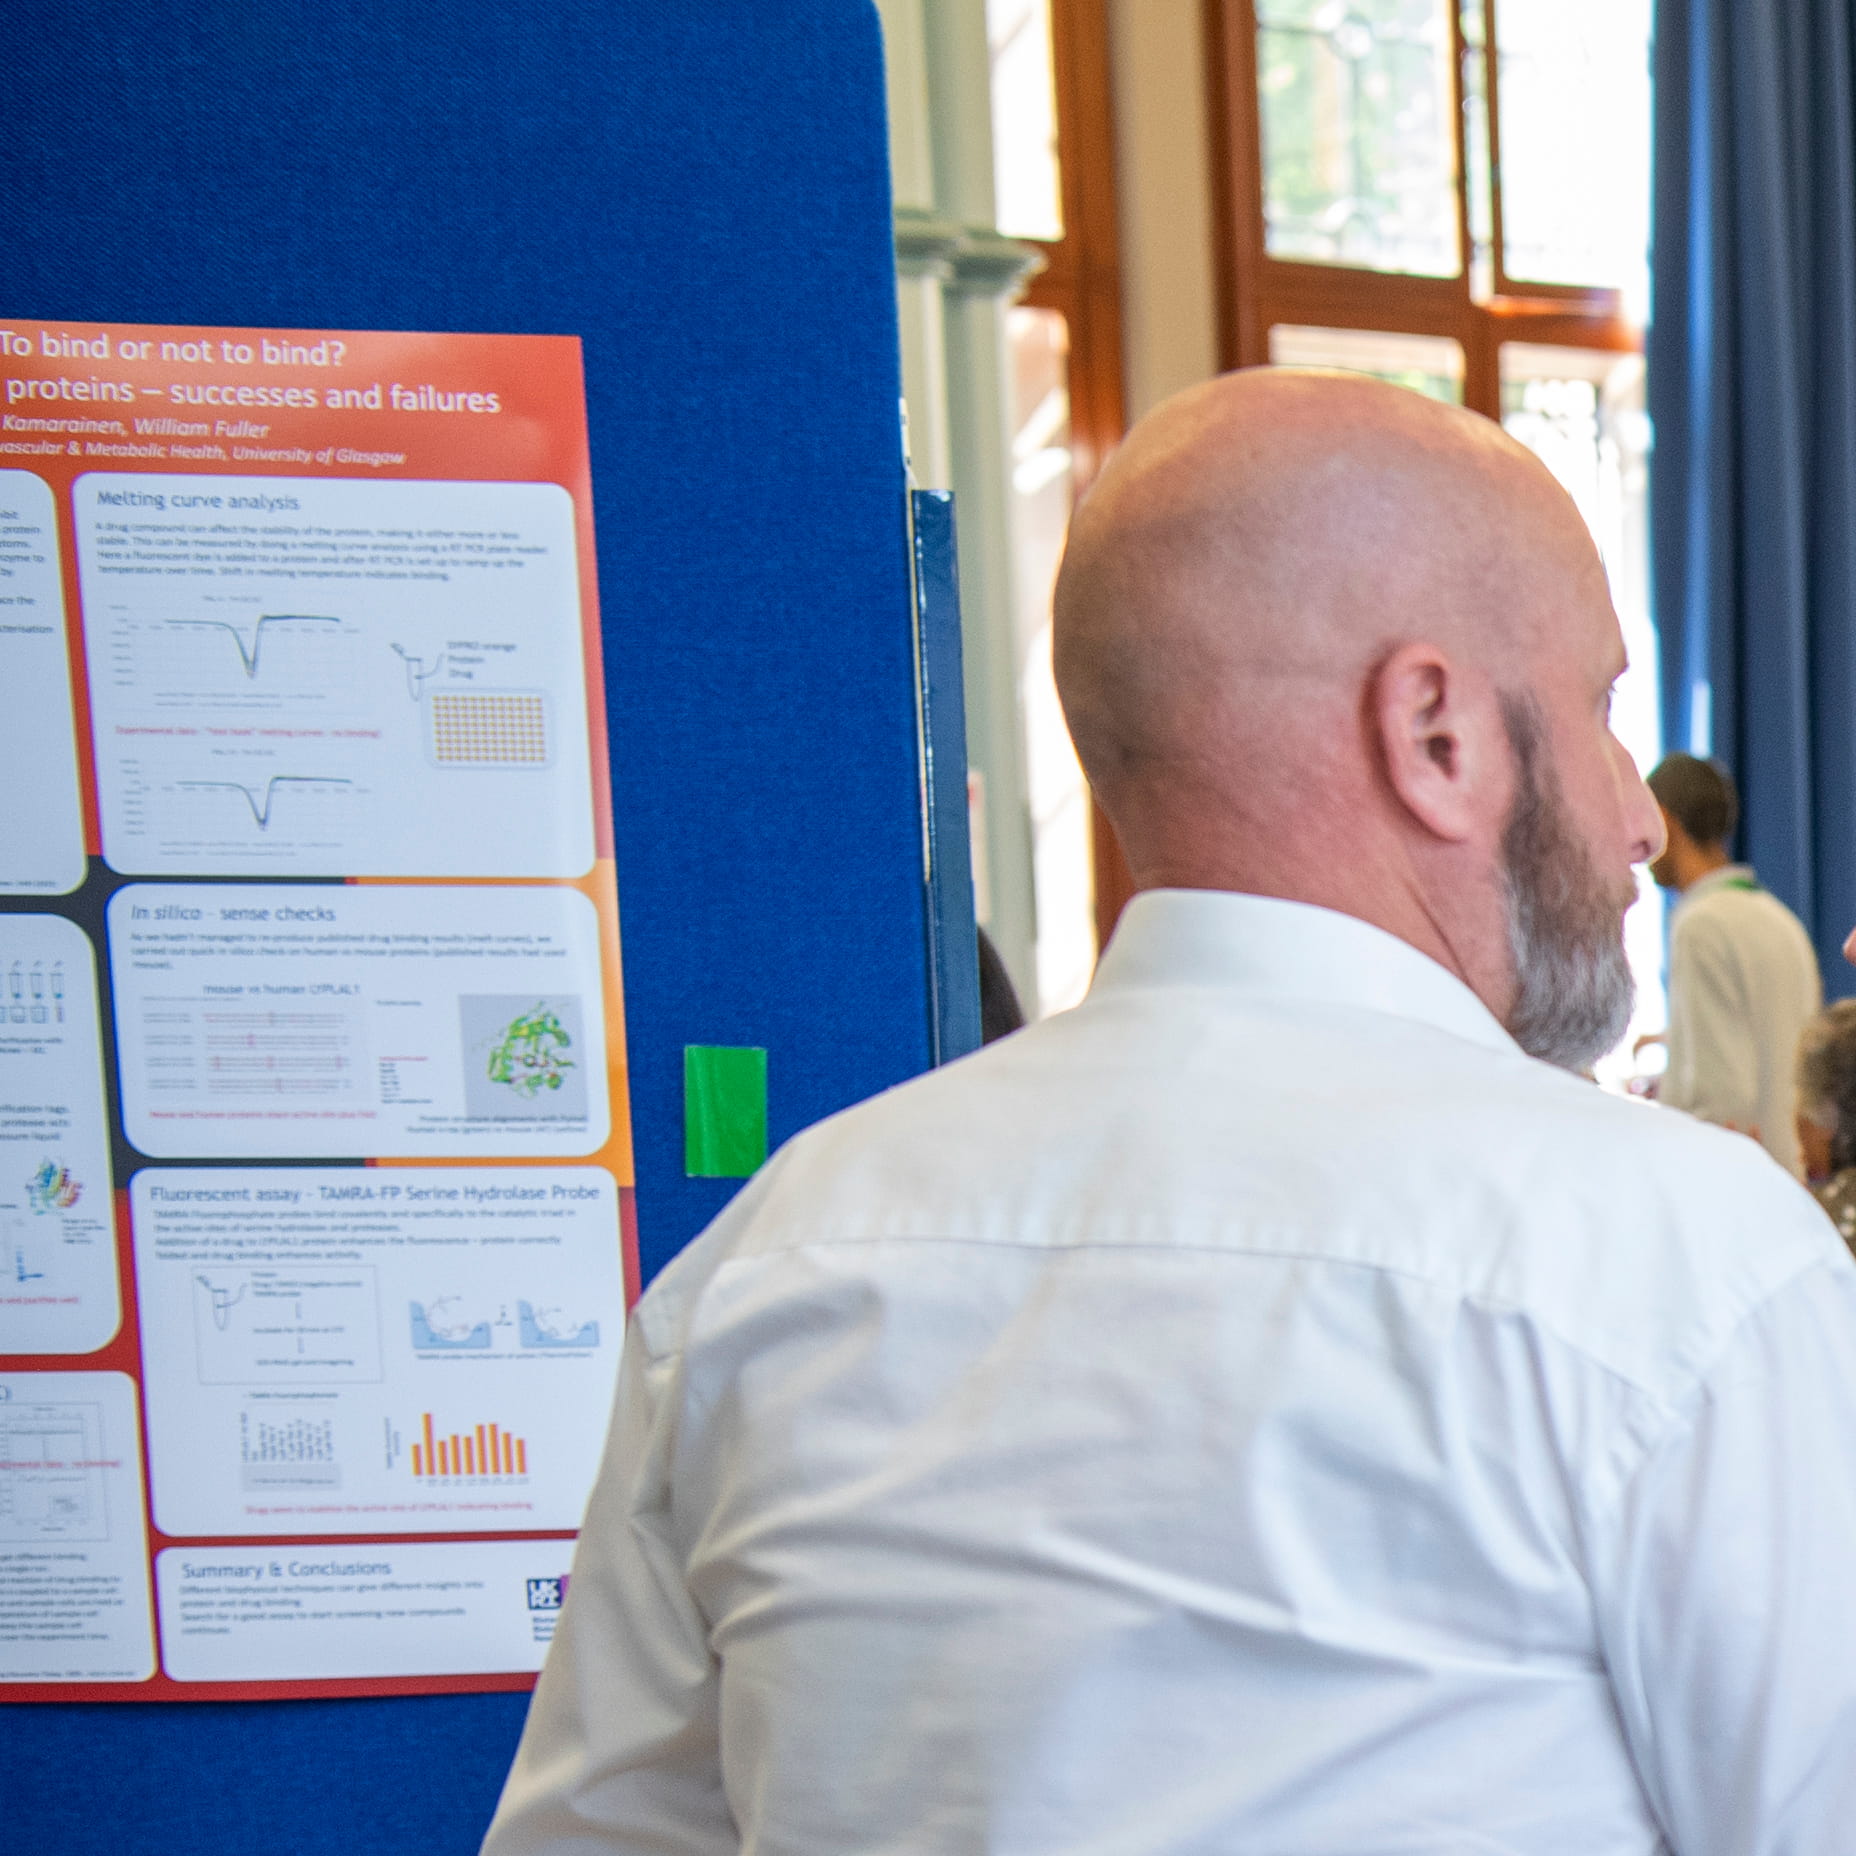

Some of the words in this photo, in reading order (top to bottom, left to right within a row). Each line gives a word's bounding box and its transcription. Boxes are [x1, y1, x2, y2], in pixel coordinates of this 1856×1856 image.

[0, 330, 32, 357] To
[41, 331, 110, 359] bind
[119, 340, 152, 360] or
[161, 340, 214, 363] not
[221, 341, 253, 364] to
[262, 338, 346, 367] bind?
[6, 376, 135, 404] proteins
[170, 383, 318, 408] successes
[325, 383, 382, 410] and
[390, 383, 501, 412] failures
[3, 414, 128, 436] Kamarainen,
[134, 417, 209, 436] William
[215, 419, 270, 438] Fuller
[67, 440, 81, 456] &
[86, 441, 165, 458] Metabolic
[169, 443, 228, 461] Health,
[232, 446, 311, 465] University
[316, 447, 334, 466] of
[336, 448, 407, 467] Glasgow
[97, 491, 165, 510] Melting
[171, 494, 222, 508] curve
[228, 494, 300, 512] analysis
[131, 905, 150, 920] In
[153, 905, 202, 920] silico
[220, 908, 269, 921] sense
[275, 905, 336, 921] checks
[150, 1186, 250, 1202] Fluorescent
[256, 1188, 301, 1205] assay
[405, 1186, 459, 1201] Serine
[463, 1185, 547, 1204] Hydrolase
[552, 1184, 600, 1200] Probe
[181, 1562, 263, 1580] Summary
[269, 1561, 283, 1577] &
[288, 1560, 392, 1577] Conclusions
